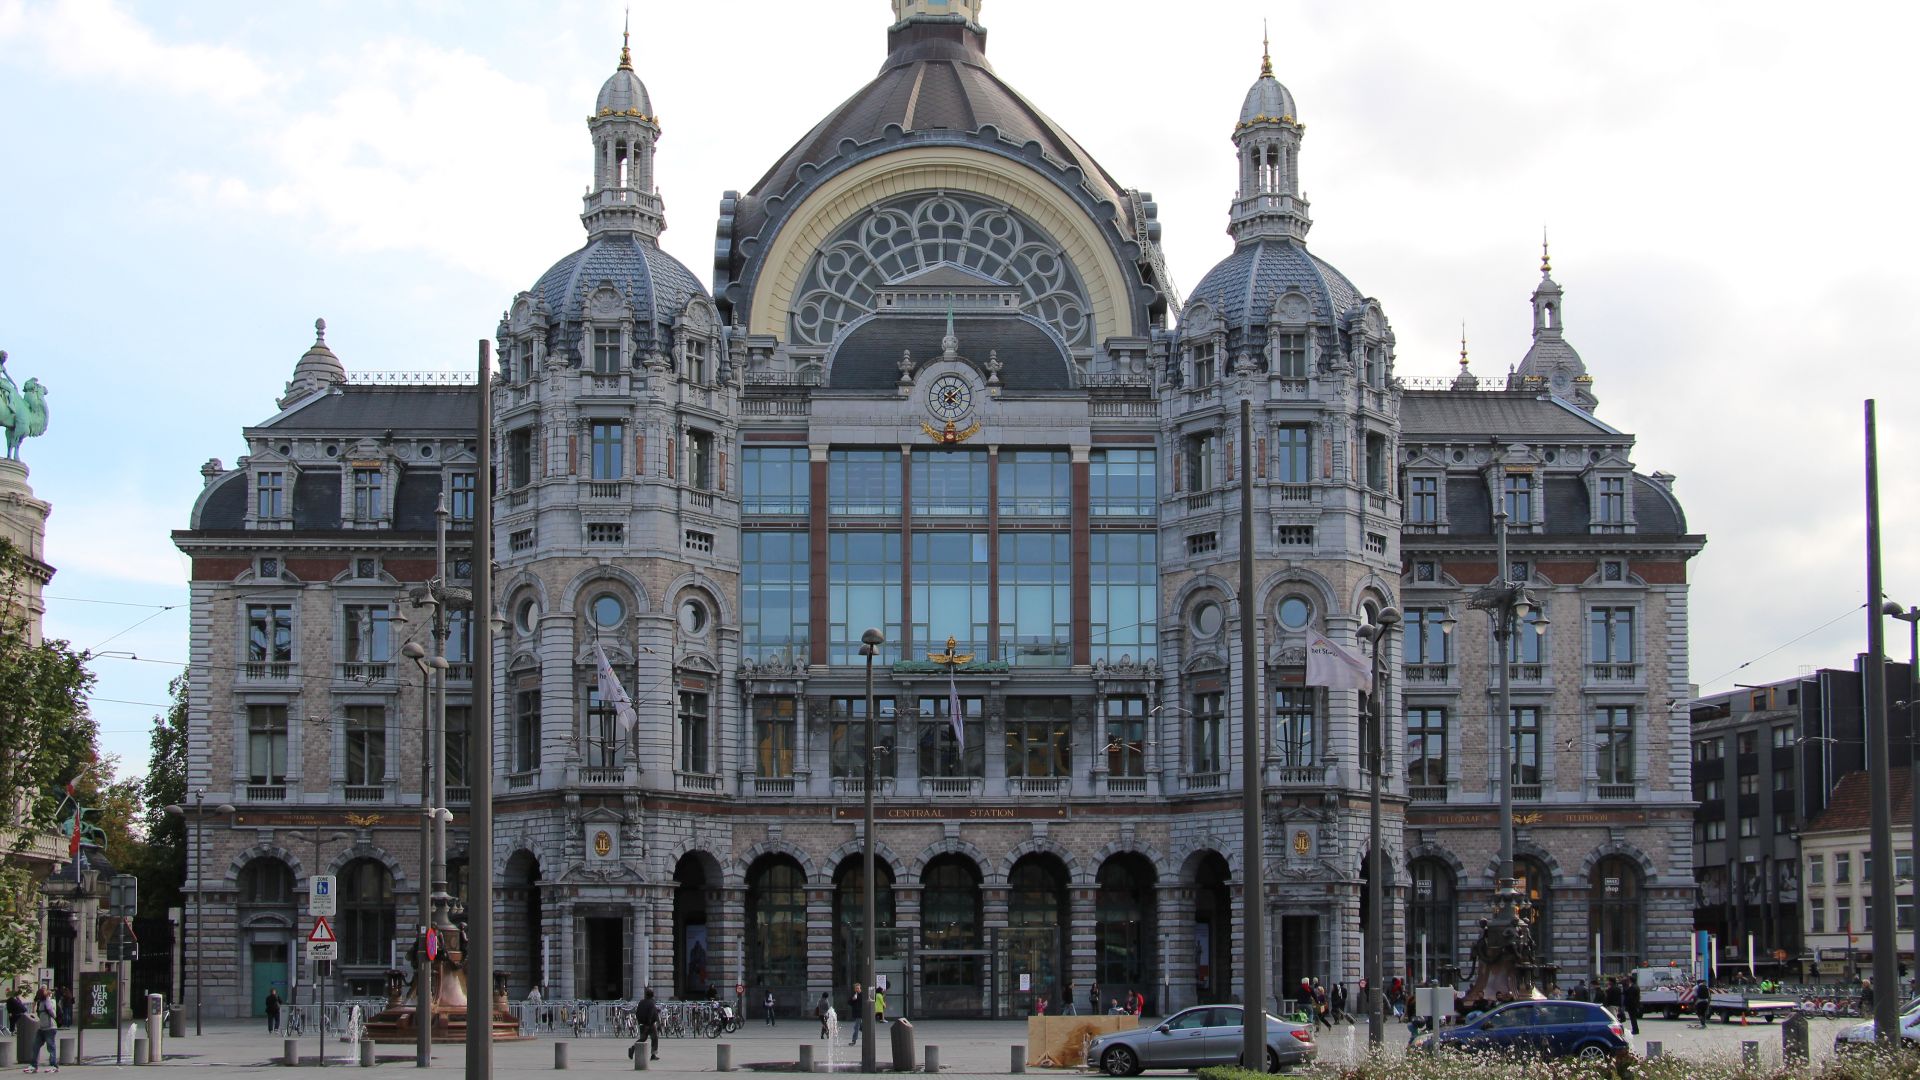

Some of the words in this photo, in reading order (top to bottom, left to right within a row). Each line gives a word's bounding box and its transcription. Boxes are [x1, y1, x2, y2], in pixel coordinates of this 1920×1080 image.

[888, 809, 945, 818] CENTRAAL
[969, 808, 1015, 818] STATION
[93, 984, 107, 992] UIT
[91, 992, 108, 1000] VER
